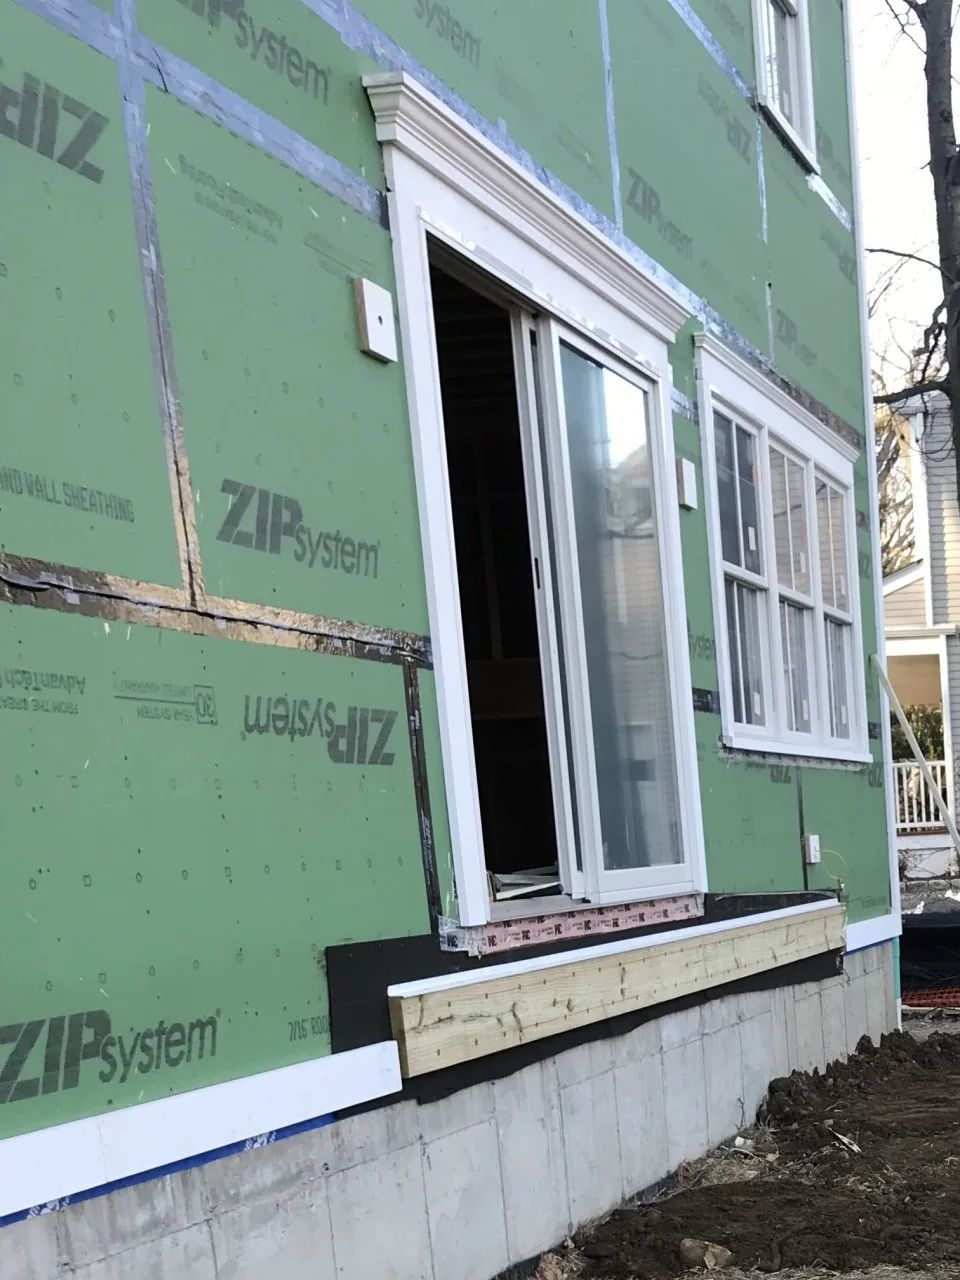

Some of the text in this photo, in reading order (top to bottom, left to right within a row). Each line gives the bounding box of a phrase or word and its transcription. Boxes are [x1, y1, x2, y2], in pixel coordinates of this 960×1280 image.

[234, 9, 331, 106] system
[414, 0, 482, 68] system
[0, 72, 110, 184] ZIP
[626, 165, 662, 224] ZIP
[23, 471, 61, 504] WALL
[61, 482, 135, 524] SHEATHING
[216, 479, 381, 579] ZIP system
[243, 694, 399, 766] ZIP system
[0, 1009, 216, 1102] ZIP system
